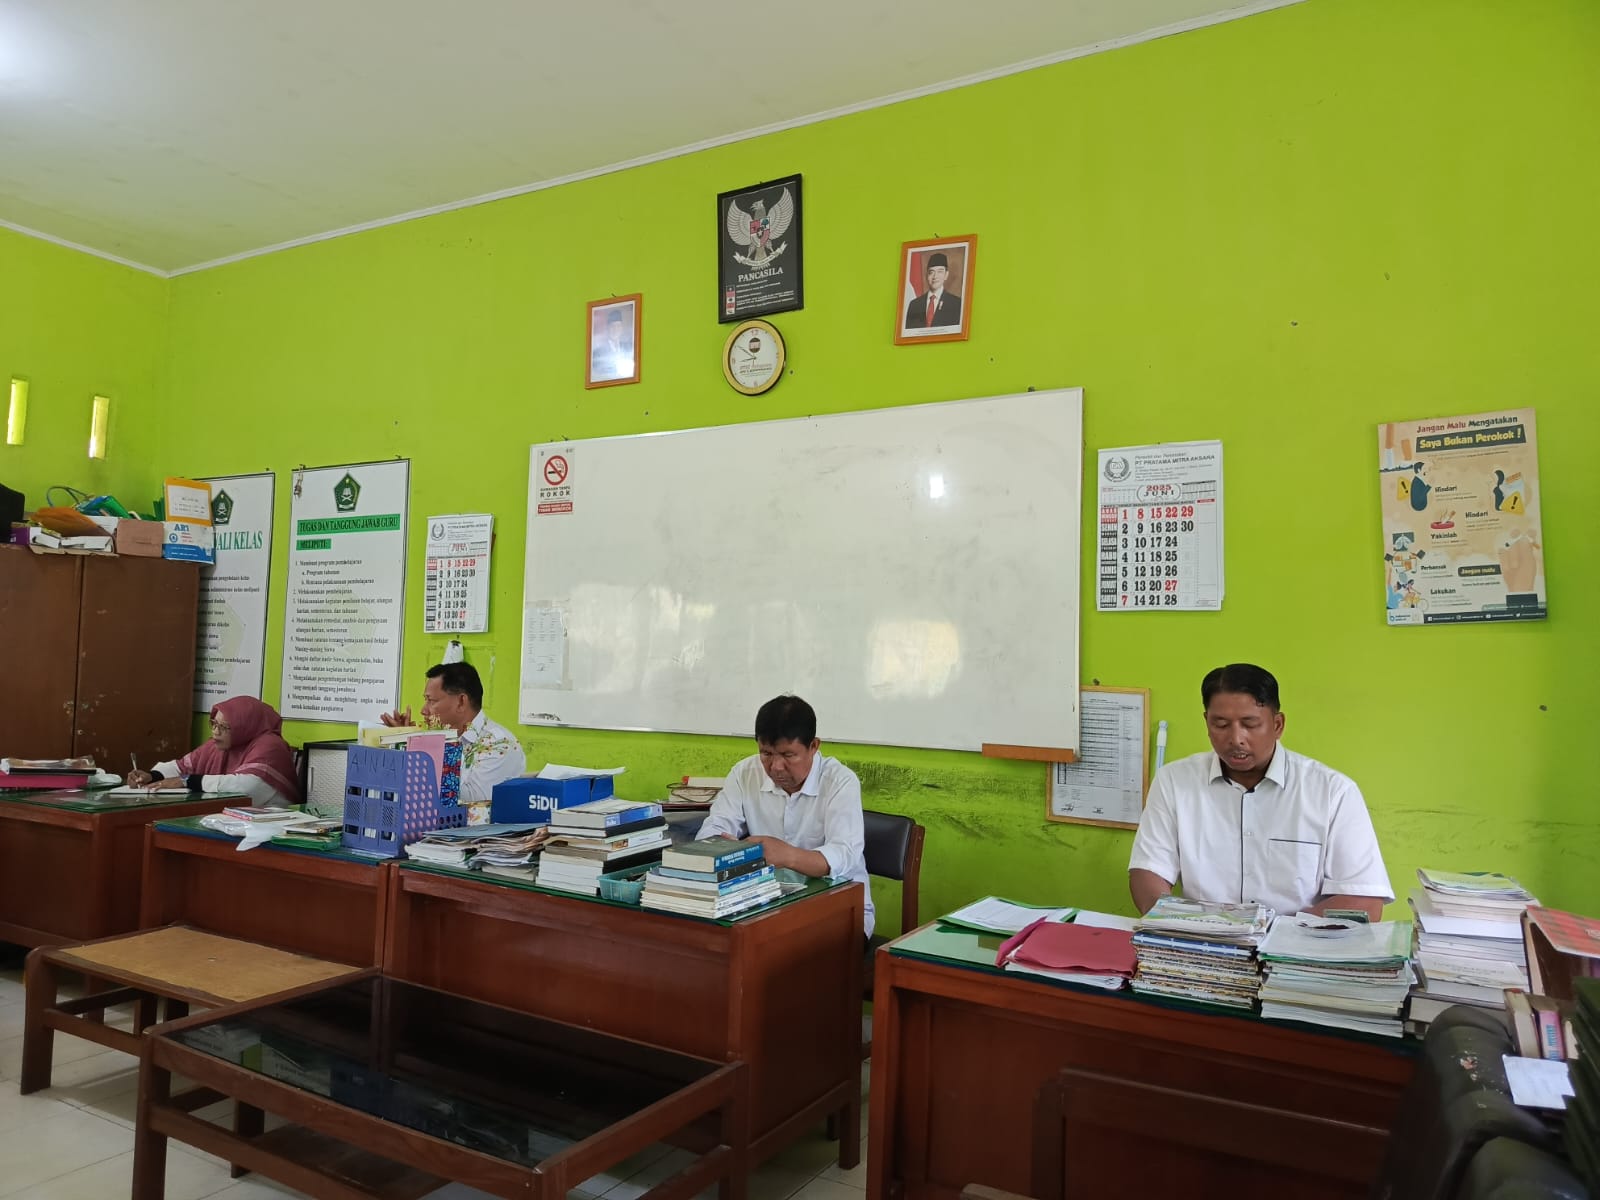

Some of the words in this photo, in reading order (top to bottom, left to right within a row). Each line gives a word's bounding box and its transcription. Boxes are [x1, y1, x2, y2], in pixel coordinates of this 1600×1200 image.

[738, 266, 784, 282] PANCASILA
[1417, 425, 1444, 433] Jangan
[1468, 416, 1517, 427] Mengatakan
[1420, 439, 1441, 448] Saya
[1444, 436, 1473, 446] Bukan
[1476, 431, 1514, 442] Perokok
[1122, 509, 1128, 520] 1
[1138, 509, 1143, 520] 8
[1151, 508, 1161, 519] 15
[1165, 507, 1177, 518] 22
[1181, 506, 1193, 517] 29
[300, 522, 317, 532] TUGAS
[318, 521, 329, 531] DAN
[330, 519, 361, 530] TANGGUNG
[361, 518, 380, 528] JAWAB
[381, 517, 398, 528] GURU
[1122, 524, 1128, 534] 2
[1138, 524, 1143, 533] 9
[1151, 522, 1162, 533] 16
[1165, 522, 1177, 532] 23
[1181, 521, 1194, 532] 30
[233, 530, 263, 549] KELAS
[1122, 538, 1128, 548] 3
[1135, 537, 1146, 547] 10
[1151, 537, 1161, 547] 17
[1165, 536, 1177, 547] 24
[1122, 552, 1128, 562] 4
[1135, 552, 1145, 562] 11
[1150, 551, 1161, 561] 18
[1165, 551, 1177, 561] 25
[440, 560, 443, 568] 1
[1122, 567, 1127, 577] 5
[1134, 566, 1146, 576] 12
[1150, 566, 1161, 576] 19
[1165, 565, 1177, 576] 26
[446, 580, 452, 588] 10
[1122, 581, 1128, 591] 6
[1134, 581, 1146, 591] 13
[1150, 580, 1161, 591] 20
[1165, 580, 1177, 591] 27
[453, 590, 459, 598] 18
[461, 590, 467, 598] 25
[1122, 596, 1128, 606] 7
[1134, 595, 1146, 605] 14
[1149, 595, 1161, 605] 21
[1165, 595, 1177, 605] 28
[438, 611, 441, 619] 6
[444, 621, 450, 629] 14
[451, 621, 457, 629] 21
[528, 794, 558, 811] SiDU
